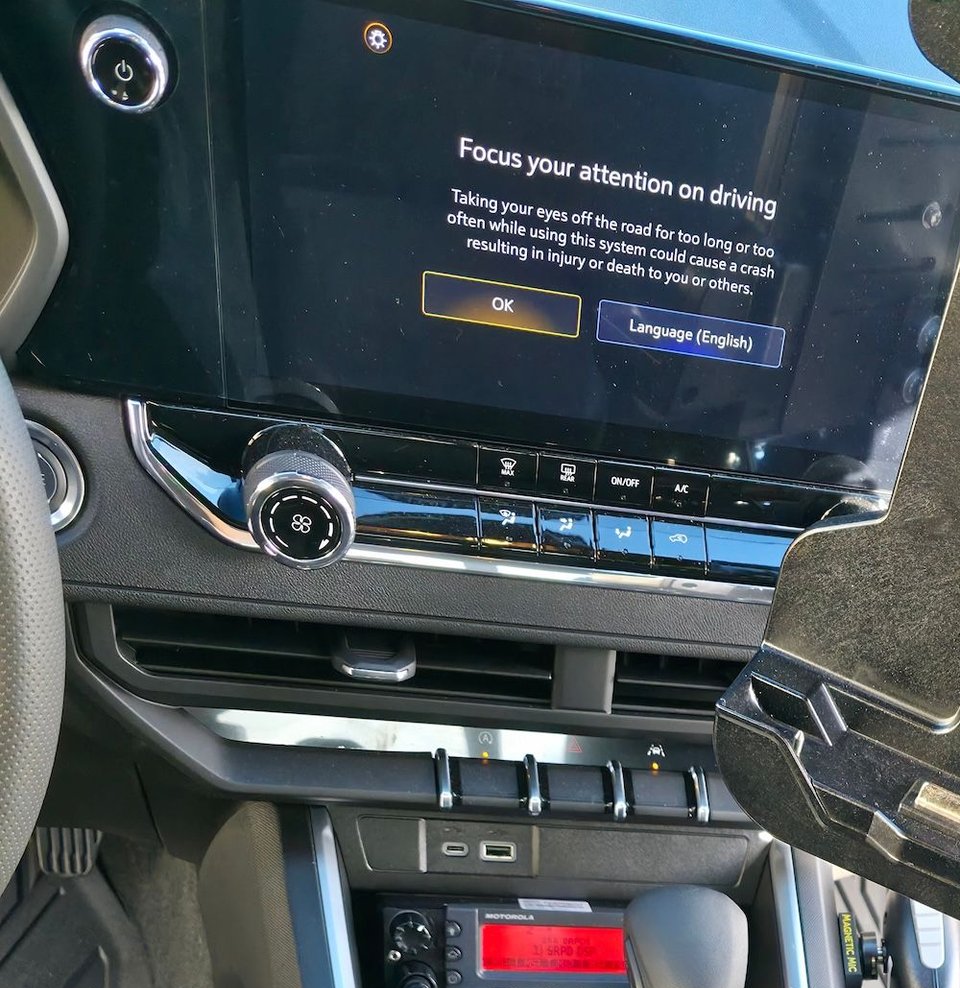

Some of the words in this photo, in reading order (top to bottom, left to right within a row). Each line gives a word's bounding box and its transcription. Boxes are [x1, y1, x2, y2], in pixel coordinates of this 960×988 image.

[460, 137, 522, 168] Focus
[526, 155, 575, 177] your
[579, 163, 673, 196] attention
[678, 183, 704, 202] on
[710, 184, 777, 220] driving
[451, 188, 498, 213] Taking
[501, 201, 534, 216] your
[536, 207, 568, 223] eyes
[571, 211, 593, 226] off
[595, 214, 618, 231] the
[621, 222, 652, 237] road
[655, 224, 675, 240] for
[678, 229, 700, 245] too
[703, 232, 732, 254] long
[736, 243, 751, 254] or
[753, 243, 775, 258] too
[447, 211, 485, 229] often
[489, 218, 526, 236] while
[530, 227, 567, 247] using
[570, 231, 596, 248] this
[599, 239, 646, 257] system
[650, 248, 686, 263] could
[689, 255, 727, 271] cause
[729, 262, 737, 272] a
[740, 264, 775, 279] crash
[467, 238, 528, 261] resulting
[532, 246, 544, 260] in
[548, 248, 586, 270] injury
[589, 259, 604, 270] or
[607, 258, 645, 277] death
[648, 266, 662, 280] to
[664, 272, 689, 285] you
[692, 276, 707, 287] or
[708, 277, 753, 296] others.
[492, 296, 515, 313] OK
[629, 318, 694, 346] Language
[696, 329, 753, 353] (English)
[501, 468, 515, 477] MAX
[560, 474, 575, 483] REAR
[611, 476, 640, 488] ON/OFF
[674, 484, 689, 494] A/C
[484, 912, 535, 921] MOTOROLA
[842, 913, 855, 955] MAGNETIC
[847, 955, 858, 973] MIC
